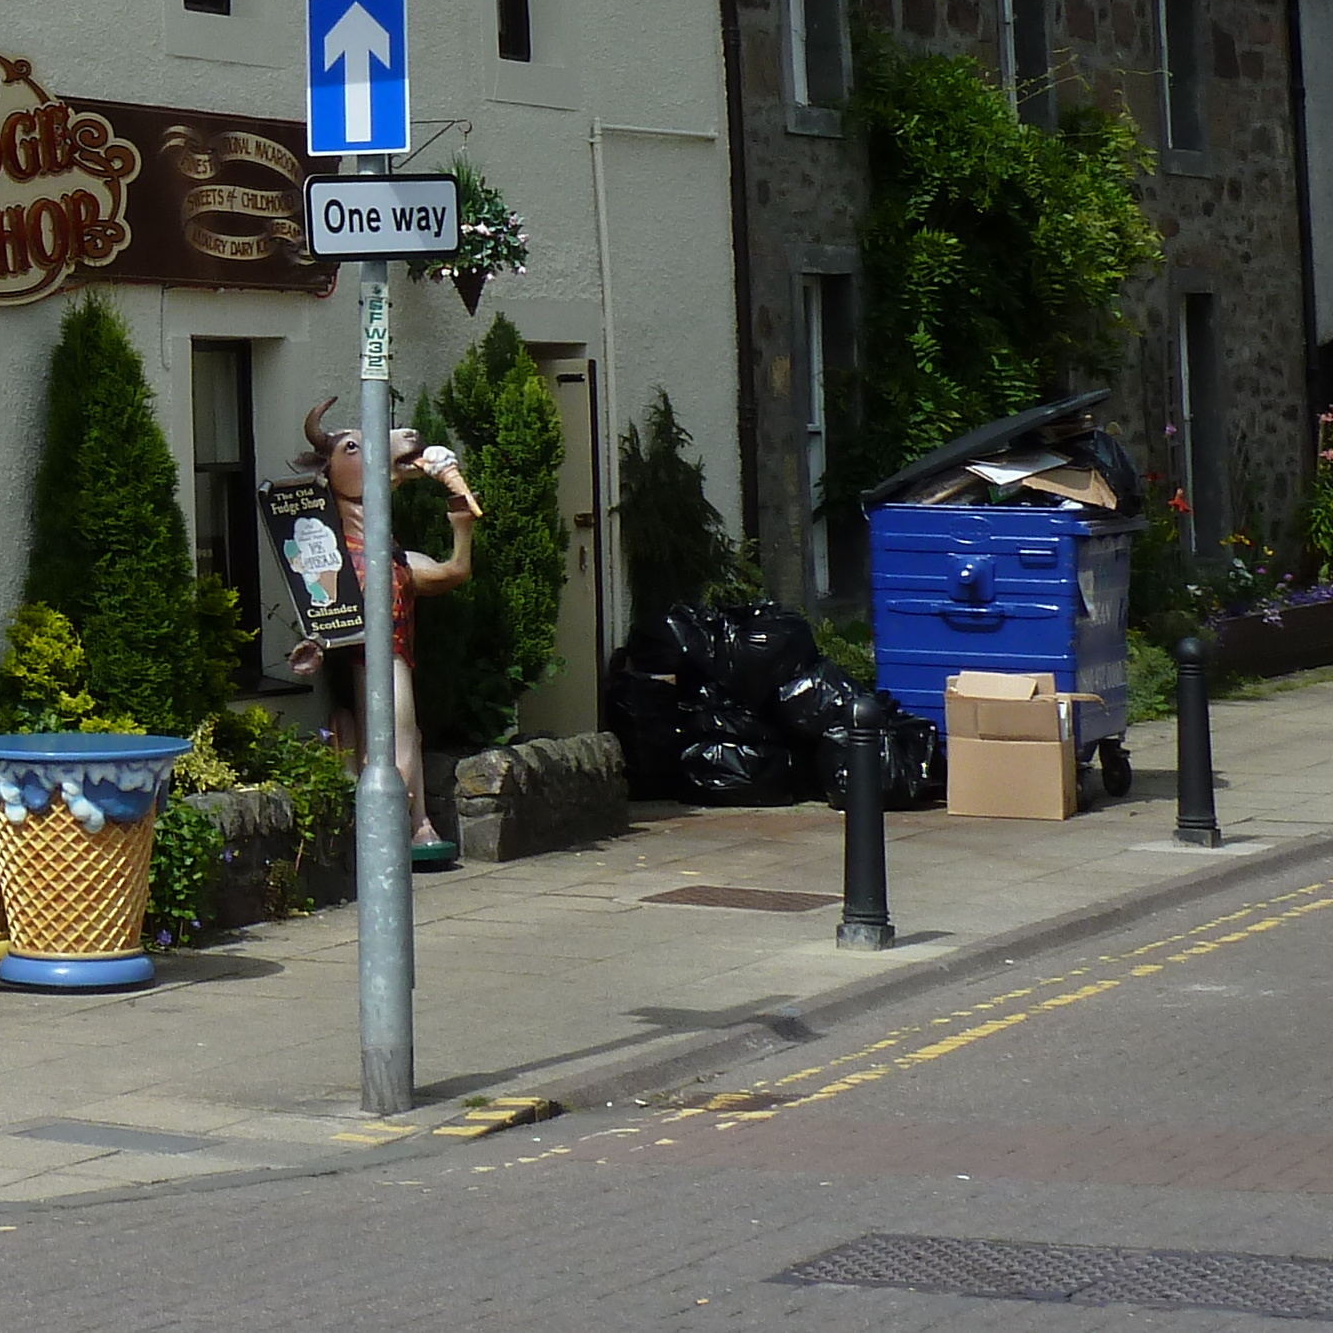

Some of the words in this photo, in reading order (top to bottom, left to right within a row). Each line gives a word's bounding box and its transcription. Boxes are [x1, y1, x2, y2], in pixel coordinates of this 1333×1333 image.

[323, 198, 382, 235] One
[392, 204, 447, 239] way
[274, 492, 294, 502] The
[295, 488, 315, 498] Old
[270, 500, 300, 516] Fudge
[300, 497, 326, 511] Shop
[306, 603, 358, 618] Callander
[310, 615, 364, 632] Scotland
